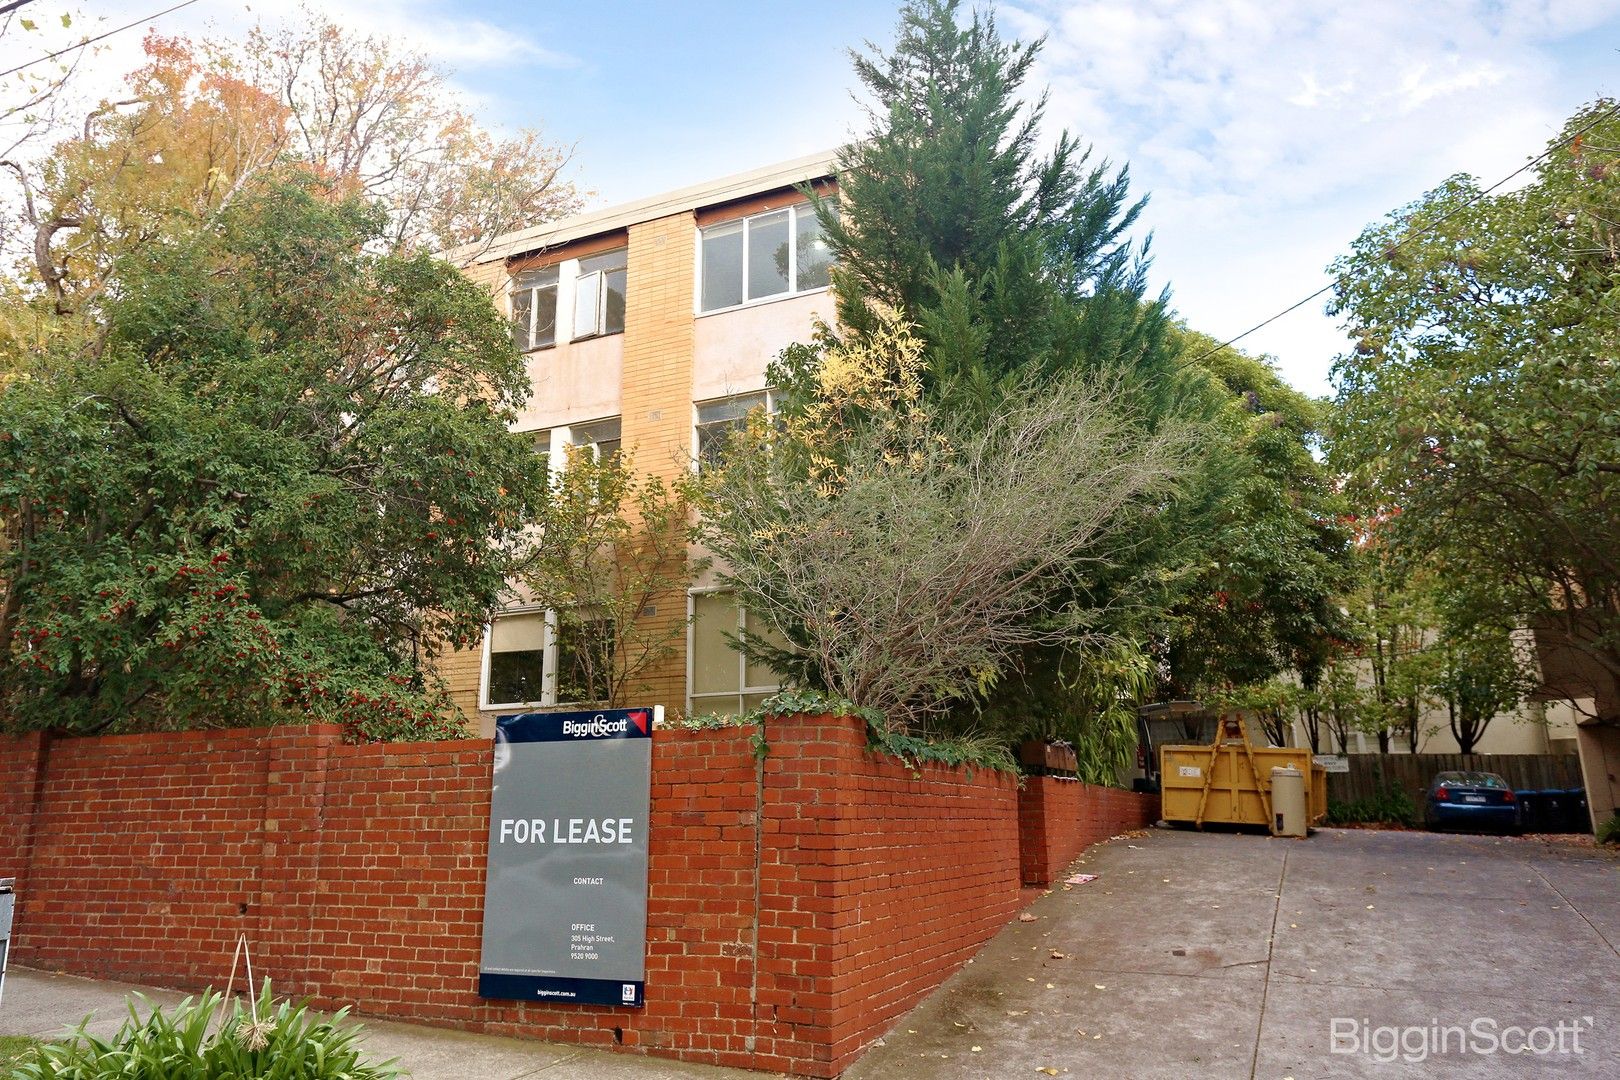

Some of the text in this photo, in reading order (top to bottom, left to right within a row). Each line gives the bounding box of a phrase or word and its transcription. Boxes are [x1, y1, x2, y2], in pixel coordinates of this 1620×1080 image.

[499, 818, 633, 844] FOR LEASE
[573, 877, 603, 885] CONTACT
[571, 923, 595, 932] OFFICE
[582, 935, 595, 944] High
[596, 935, 615, 943] Street,
[570, 952, 599, 960] 9520 9000
[537, 989, 576, 998] bigginscott.com.au
